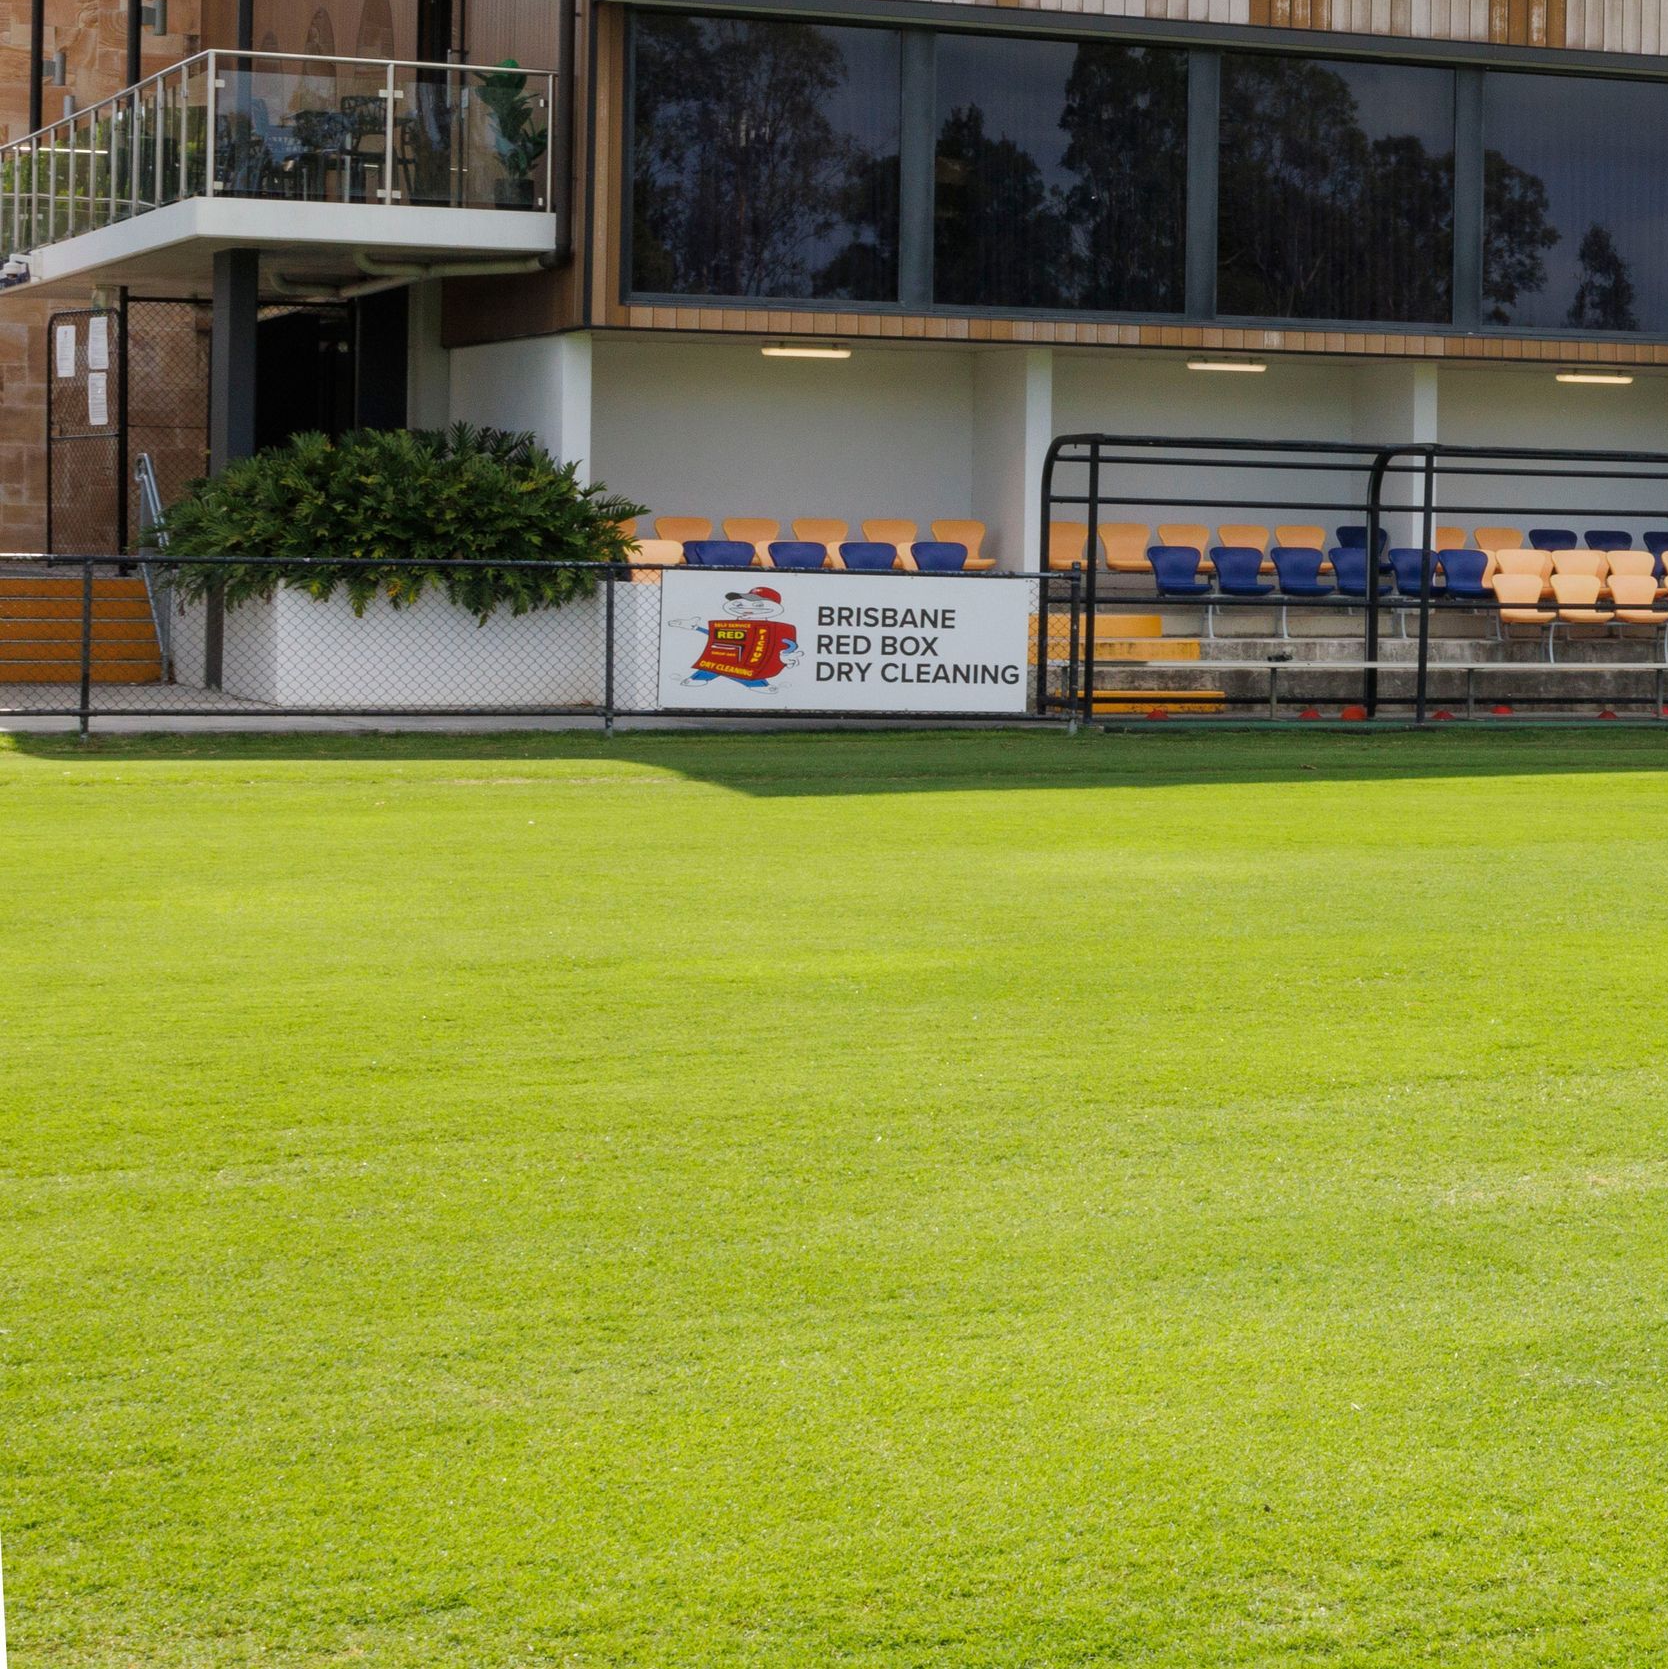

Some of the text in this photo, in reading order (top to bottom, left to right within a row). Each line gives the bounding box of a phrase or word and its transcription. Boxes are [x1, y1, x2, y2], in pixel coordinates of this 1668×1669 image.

[818, 606, 956, 629] BRISBANE
[717, 630, 745, 639] RED
[816, 634, 939, 656] RED BOX
[700, 660, 753, 677] DRY CLEANING
[816, 662, 1020, 685] DRY CLEANING
